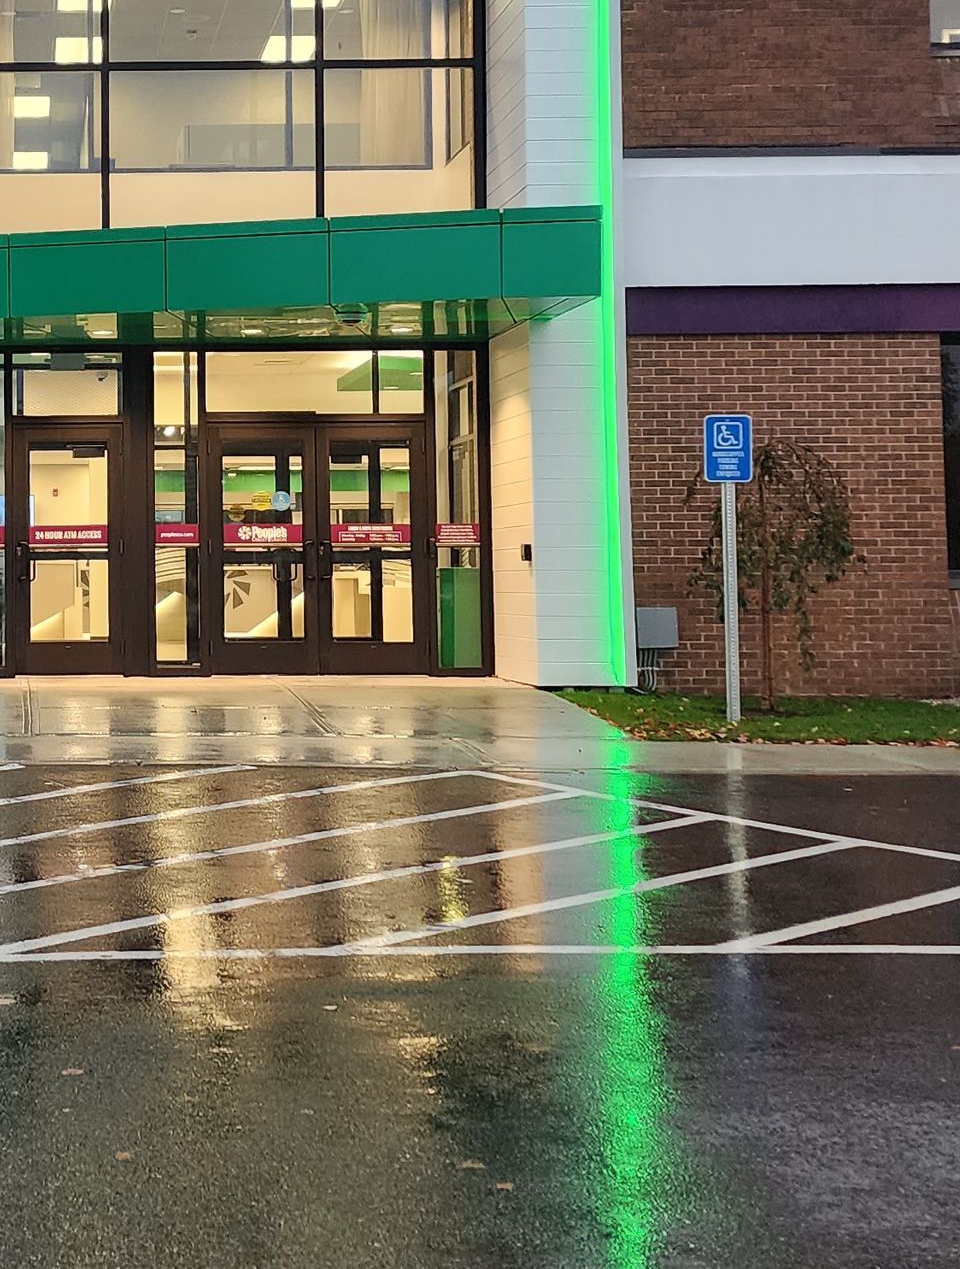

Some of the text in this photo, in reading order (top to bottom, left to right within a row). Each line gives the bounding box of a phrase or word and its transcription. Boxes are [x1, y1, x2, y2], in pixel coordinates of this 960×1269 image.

[35, 530, 102, 539] 24 HOUR ATM ACCESS
[252, 526, 287, 542] People's
